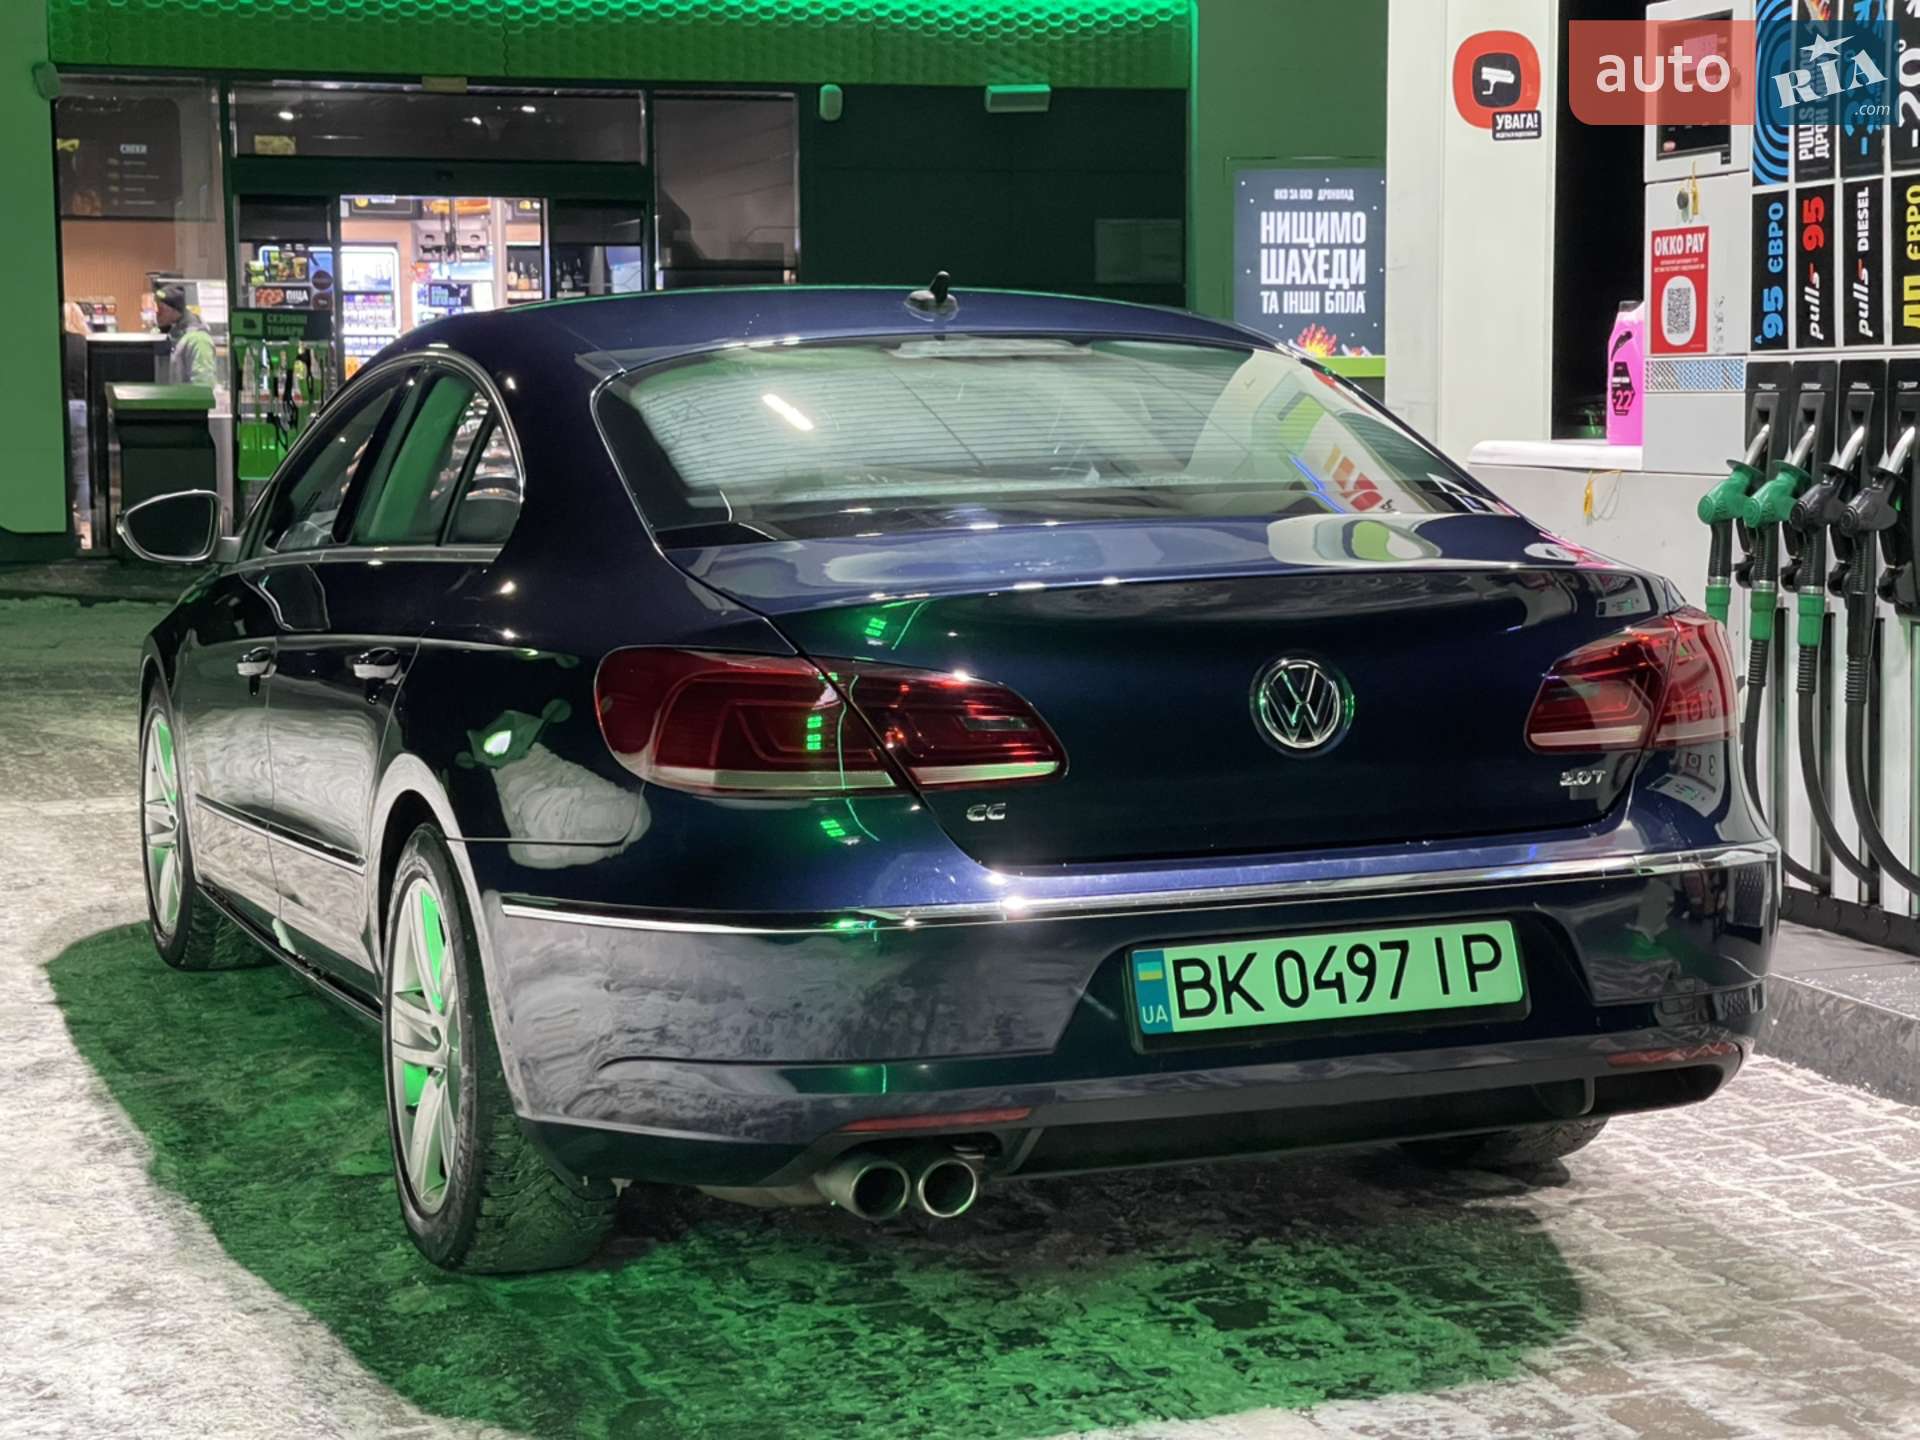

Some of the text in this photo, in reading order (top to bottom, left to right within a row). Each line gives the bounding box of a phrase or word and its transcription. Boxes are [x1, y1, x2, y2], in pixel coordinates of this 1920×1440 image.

[1495, 113, 1539, 130] УВАГА!
[1799, 107, 1815, 161] PULLS
[1814, 108, 1830, 159] ДРОН
[1260, 211, 1367, 248] НИЩИМО
[1654, 232, 1706, 257] OKKO PAY
[1767, 202, 1784, 273] ЄВРО
[1260, 248, 1366, 290] ШАХЕДИ
[1803, 196, 1825, 340] pulls 95
[1853, 187, 1873, 338] pulls DIESEL
[1260, 291, 1279, 314] ТА
[1283, 291, 1320, 314] ІНШІ
[1763, 286, 1784, 339] 95
[1560, 770, 1606, 787] 2.0T
[966, 802, 1006, 822] CC
[1172, 933, 1503, 1019] BK 0497 IP
[1142, 1004, 1169, 1024] UA
